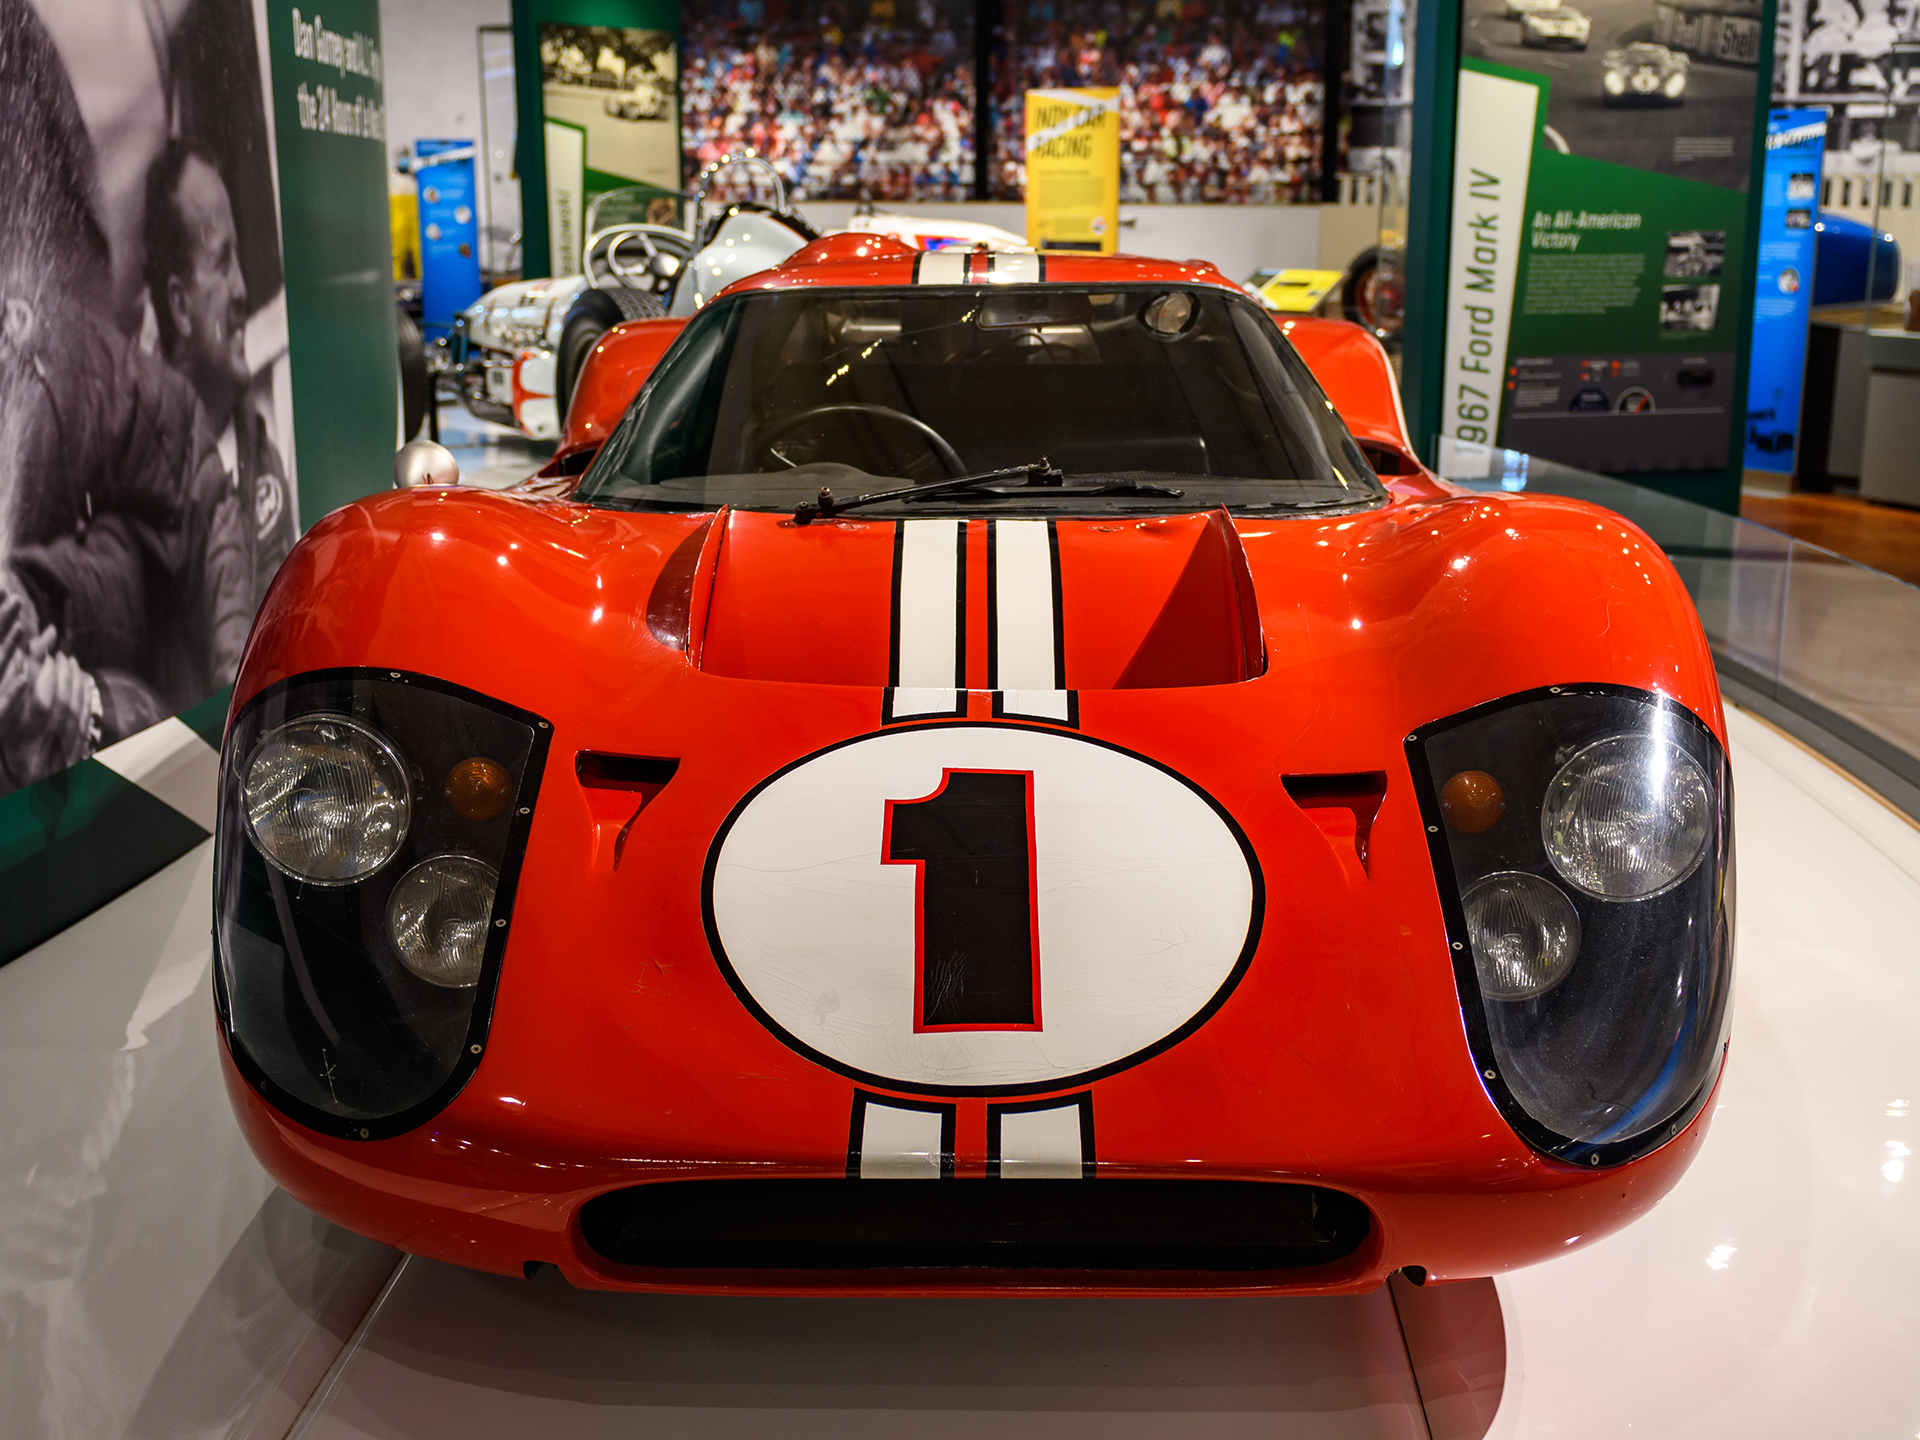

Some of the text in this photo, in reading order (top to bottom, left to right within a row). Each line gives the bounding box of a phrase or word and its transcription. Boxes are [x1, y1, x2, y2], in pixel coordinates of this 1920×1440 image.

[292, 7, 315, 60] Dan
[314, 14, 346, 79] Gurney
[1721, 22, 1758, 58] Shell
[297, 81, 317, 131] the
[1036, 133, 1093, 159] RACING
[1531, 231, 1581, 252] Victory
[1532, 210, 1642, 230] An All-American
[1454, 166, 1502, 454] 1967 Ford Mark IV
[881, 767, 1044, 1034] 1
